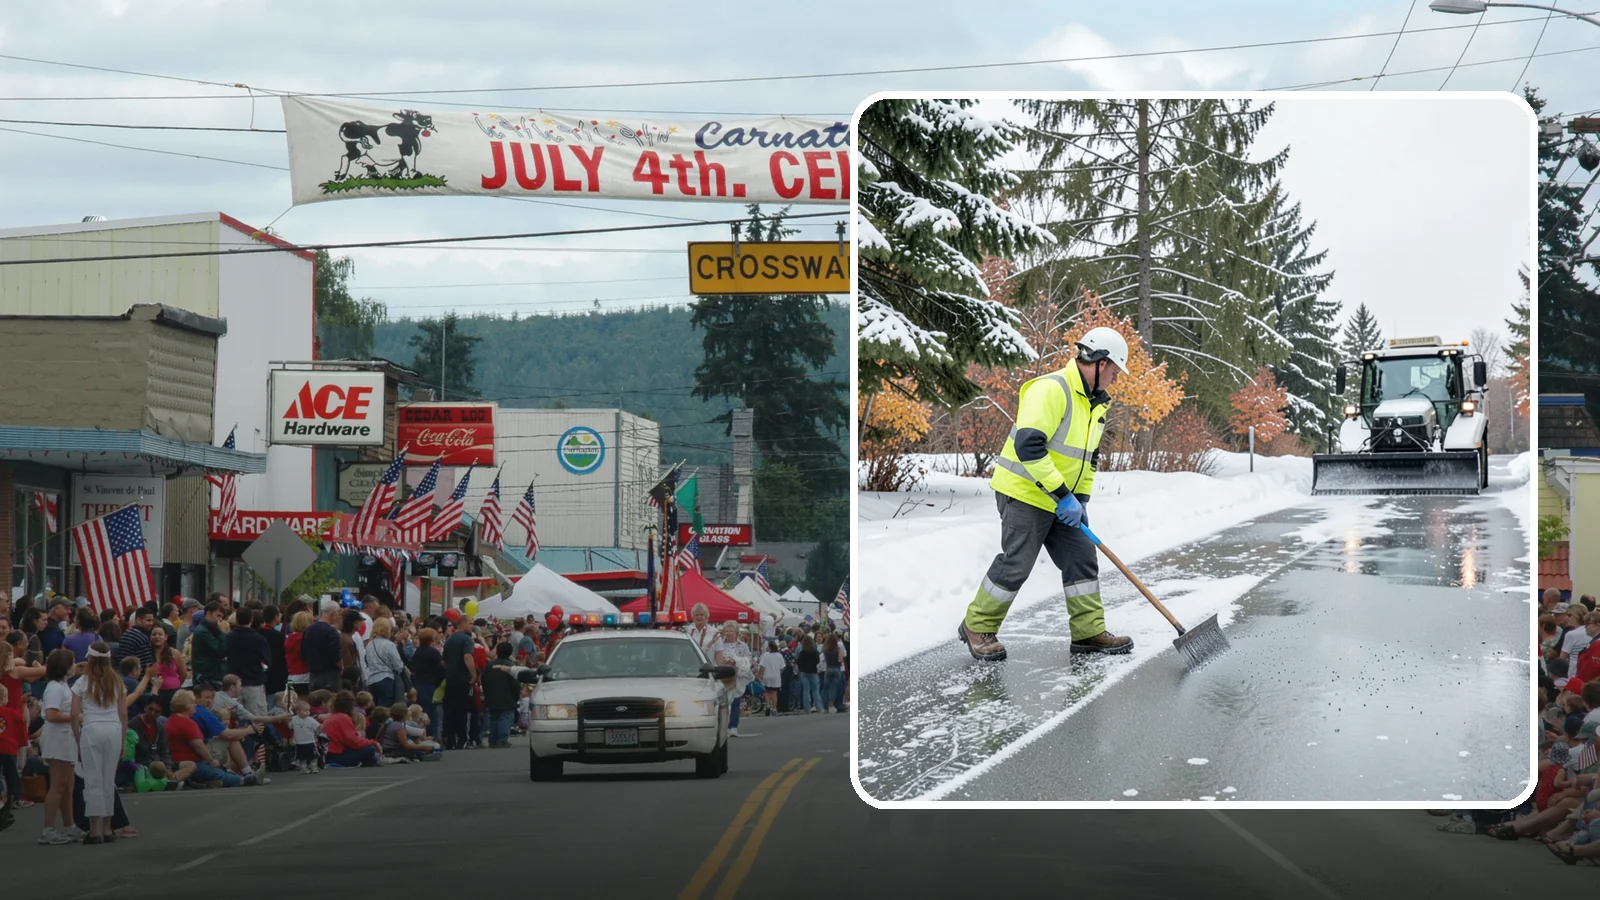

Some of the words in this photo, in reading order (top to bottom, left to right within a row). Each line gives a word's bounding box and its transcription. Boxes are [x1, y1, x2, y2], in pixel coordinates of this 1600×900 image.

[481, 141, 605, 193] JULY
[632, 150, 746, 198] 4th.
[697, 254, 850, 280] CROSSWA
[283, 380, 373, 420] ACE
[405, 409, 453, 421] CEDAR
[461, 409, 485, 421] LOG
[283, 421, 370, 436] Hardware
[417, 428, 477, 446] Coca-Cola
[353, 467, 386, 481] Simpl
[96, 485, 124, 495] Vincent
[126, 486, 136, 494] de
[137, 486, 155, 495] Paul
[81, 503, 153, 522] THRT
[688, 526, 741, 535] CRNATION
[699, 535, 730, 543] GLASS
